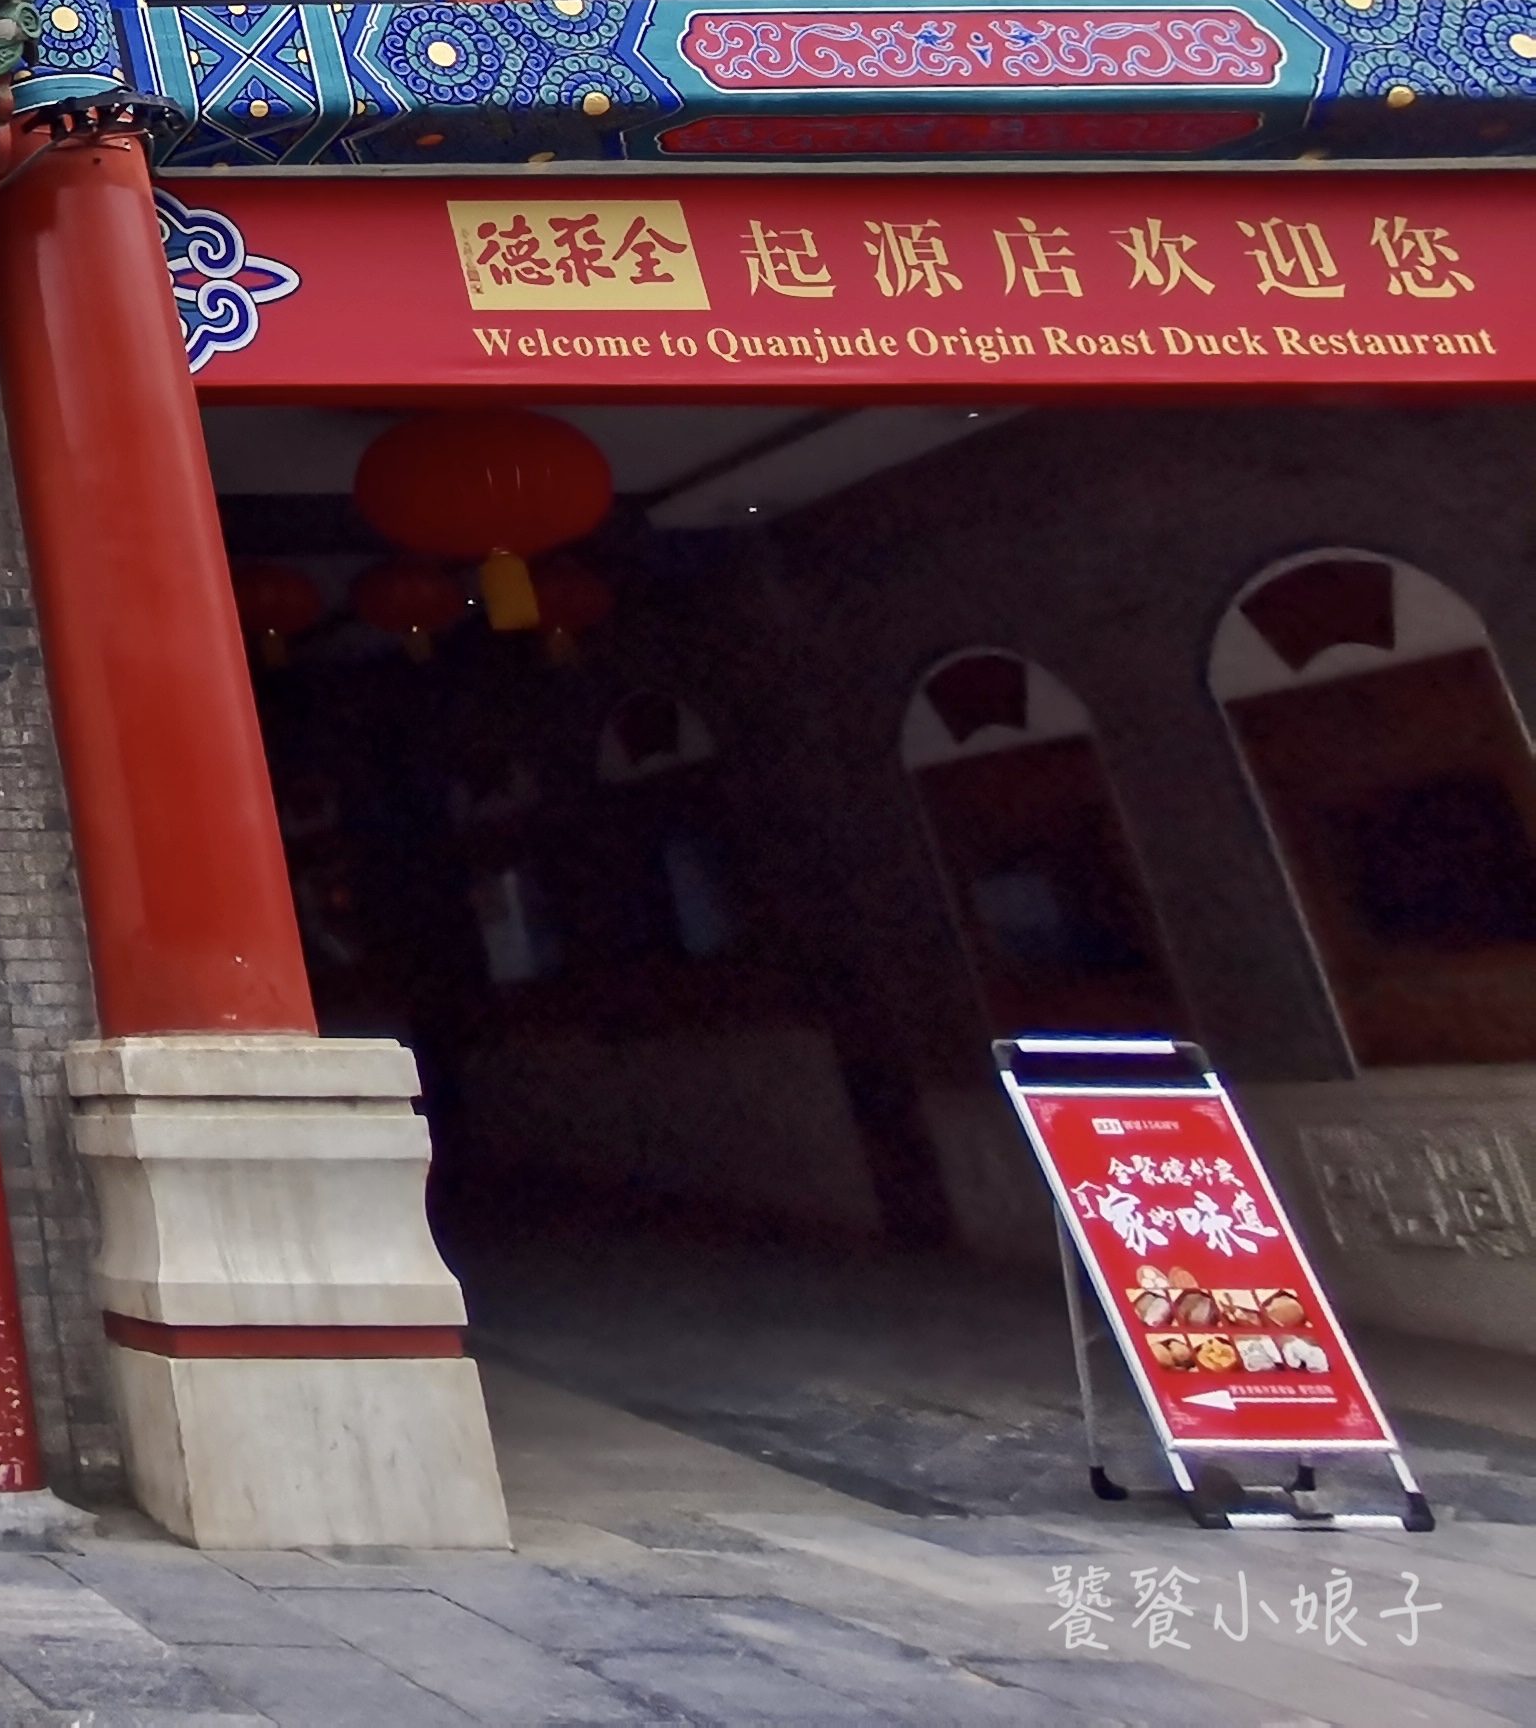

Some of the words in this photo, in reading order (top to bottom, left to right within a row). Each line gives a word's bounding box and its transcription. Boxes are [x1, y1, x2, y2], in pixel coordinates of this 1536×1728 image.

[739, 216, 1476, 299] 起源店欢迎您
[472, 327, 651, 358] Welcome
[660, 330, 698, 357] to
[707, 326, 898, 364] Quanjude
[906, 326, 1036, 364] Origin
[1040, 326, 1157, 357] Roast
[1159, 326, 1266, 357] Duck
[1272, 326, 1497, 357] Restaurant
